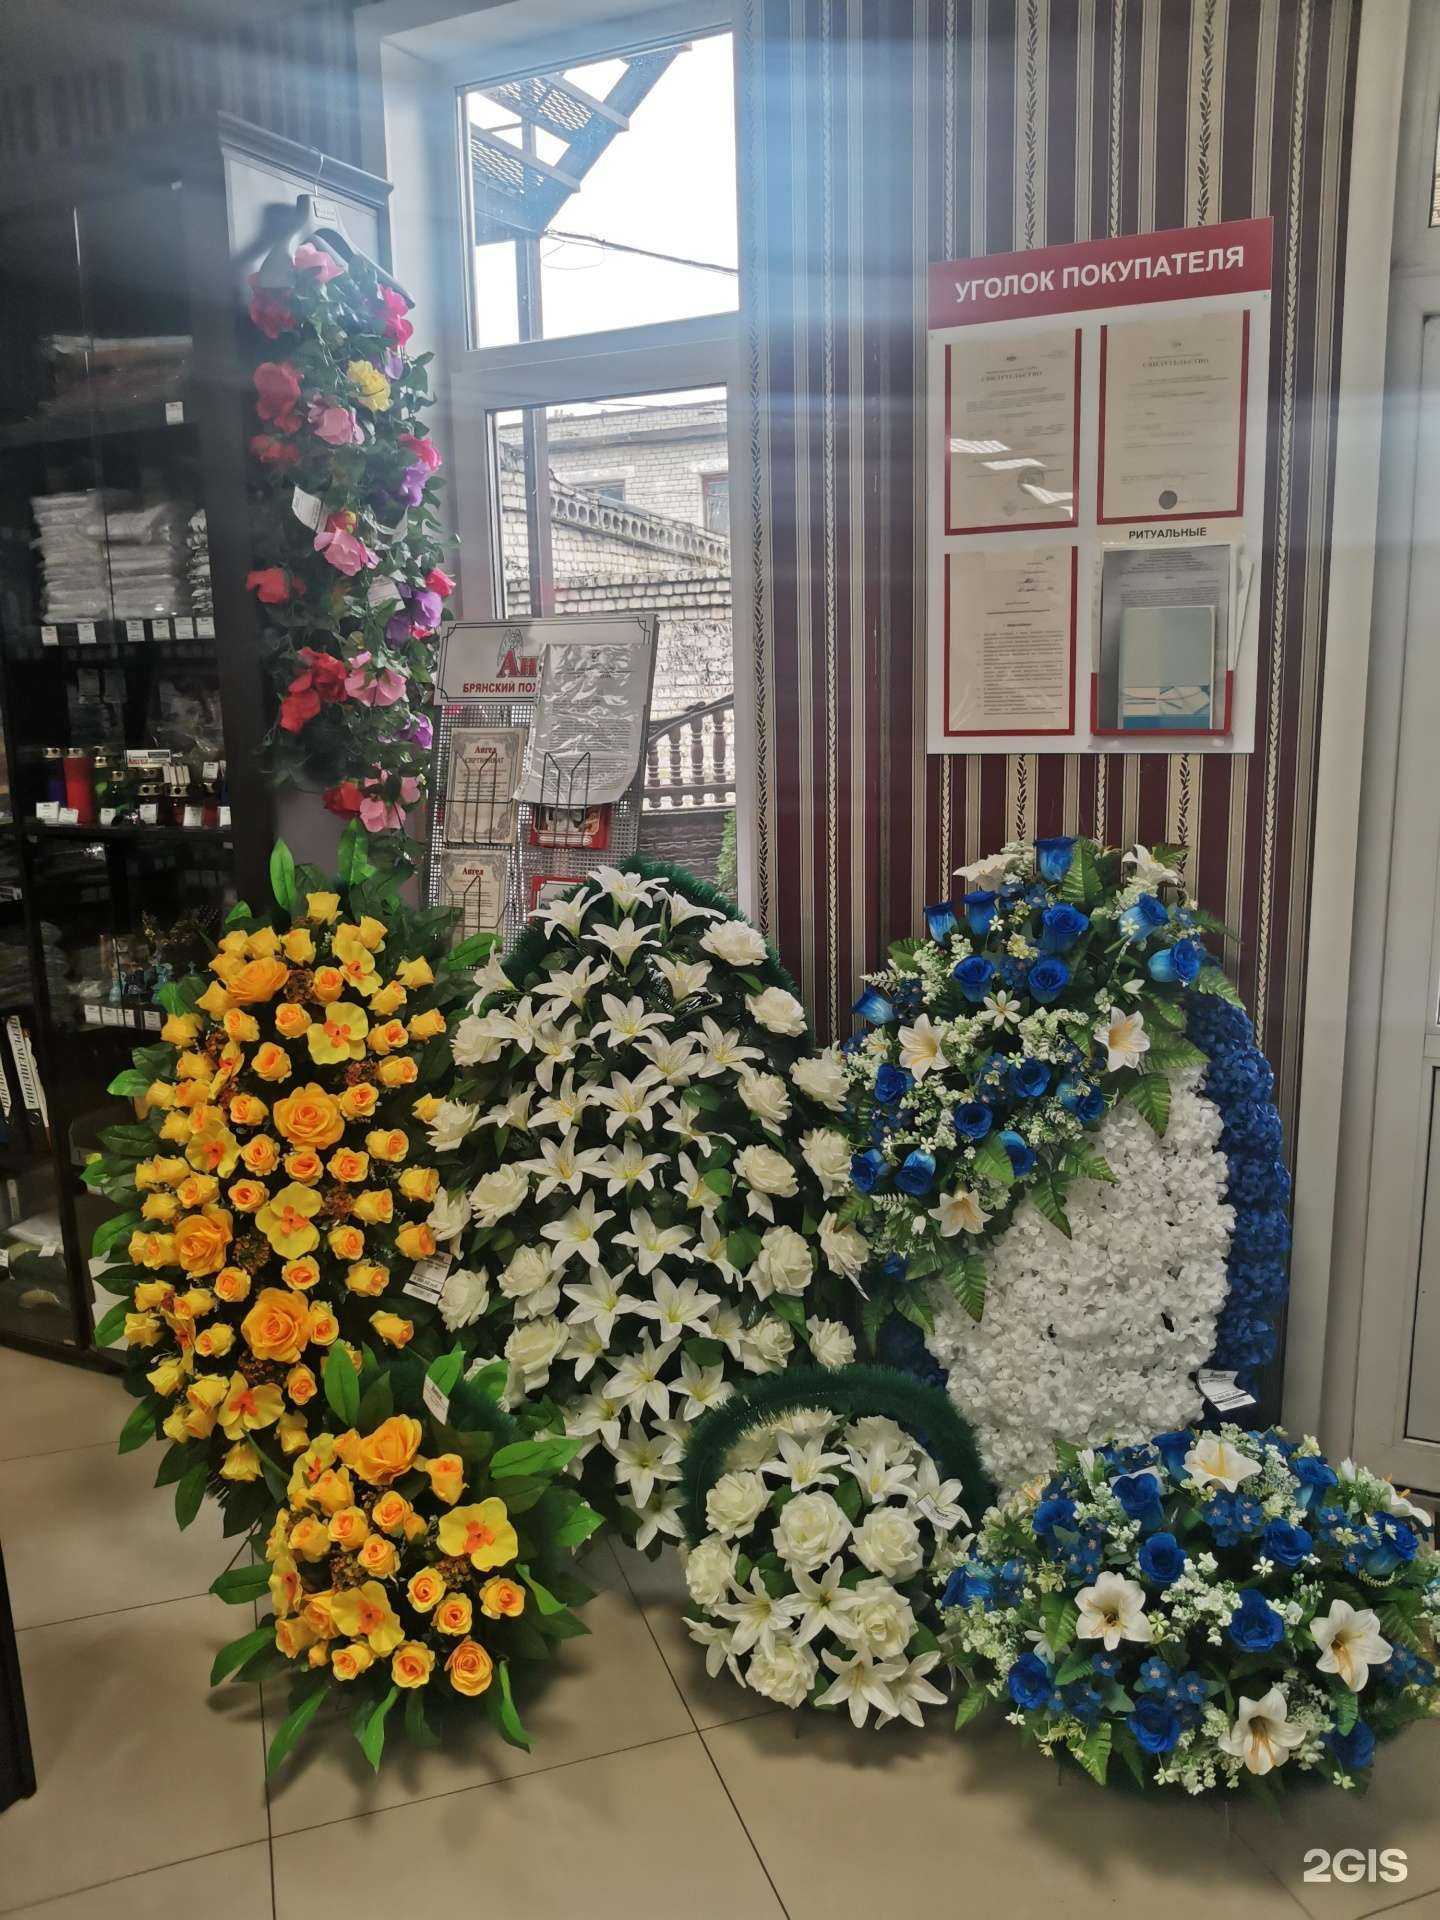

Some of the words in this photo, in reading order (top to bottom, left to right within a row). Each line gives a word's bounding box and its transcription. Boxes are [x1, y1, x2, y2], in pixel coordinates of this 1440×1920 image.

[955, 270, 1055, 303] УГОЛОК
[1062, 246, 1244, 289] ПОКУПАТЕЛЯ
[1128, 527, 1208, 540] РИТУАЛЬНЫЕ
